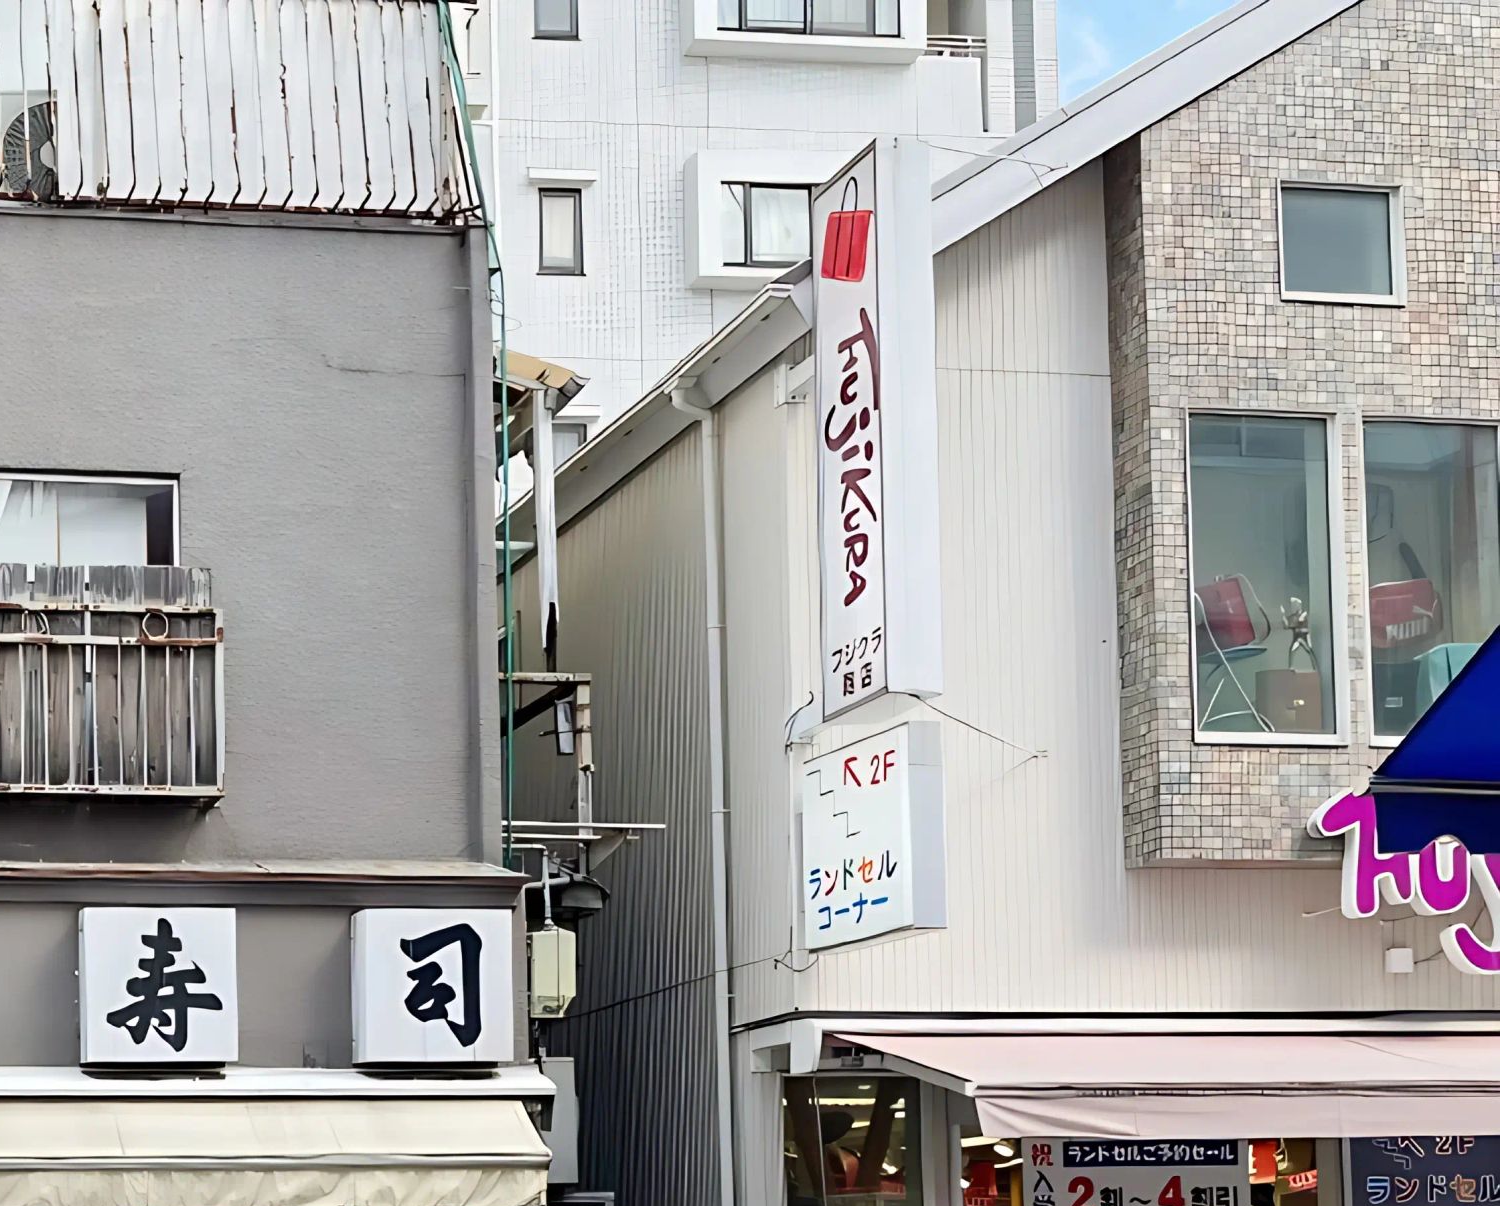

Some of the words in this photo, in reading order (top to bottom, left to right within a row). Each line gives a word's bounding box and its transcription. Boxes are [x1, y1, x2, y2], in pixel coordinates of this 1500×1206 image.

[831, 626, 882, 673] フジクラ
[869, 749, 896, 785] 2F
[808, 850, 898, 900] ランドセル
[817, 892, 889, 930] コーナー
[1367, 1174, 1500, 1204] ランドセル
